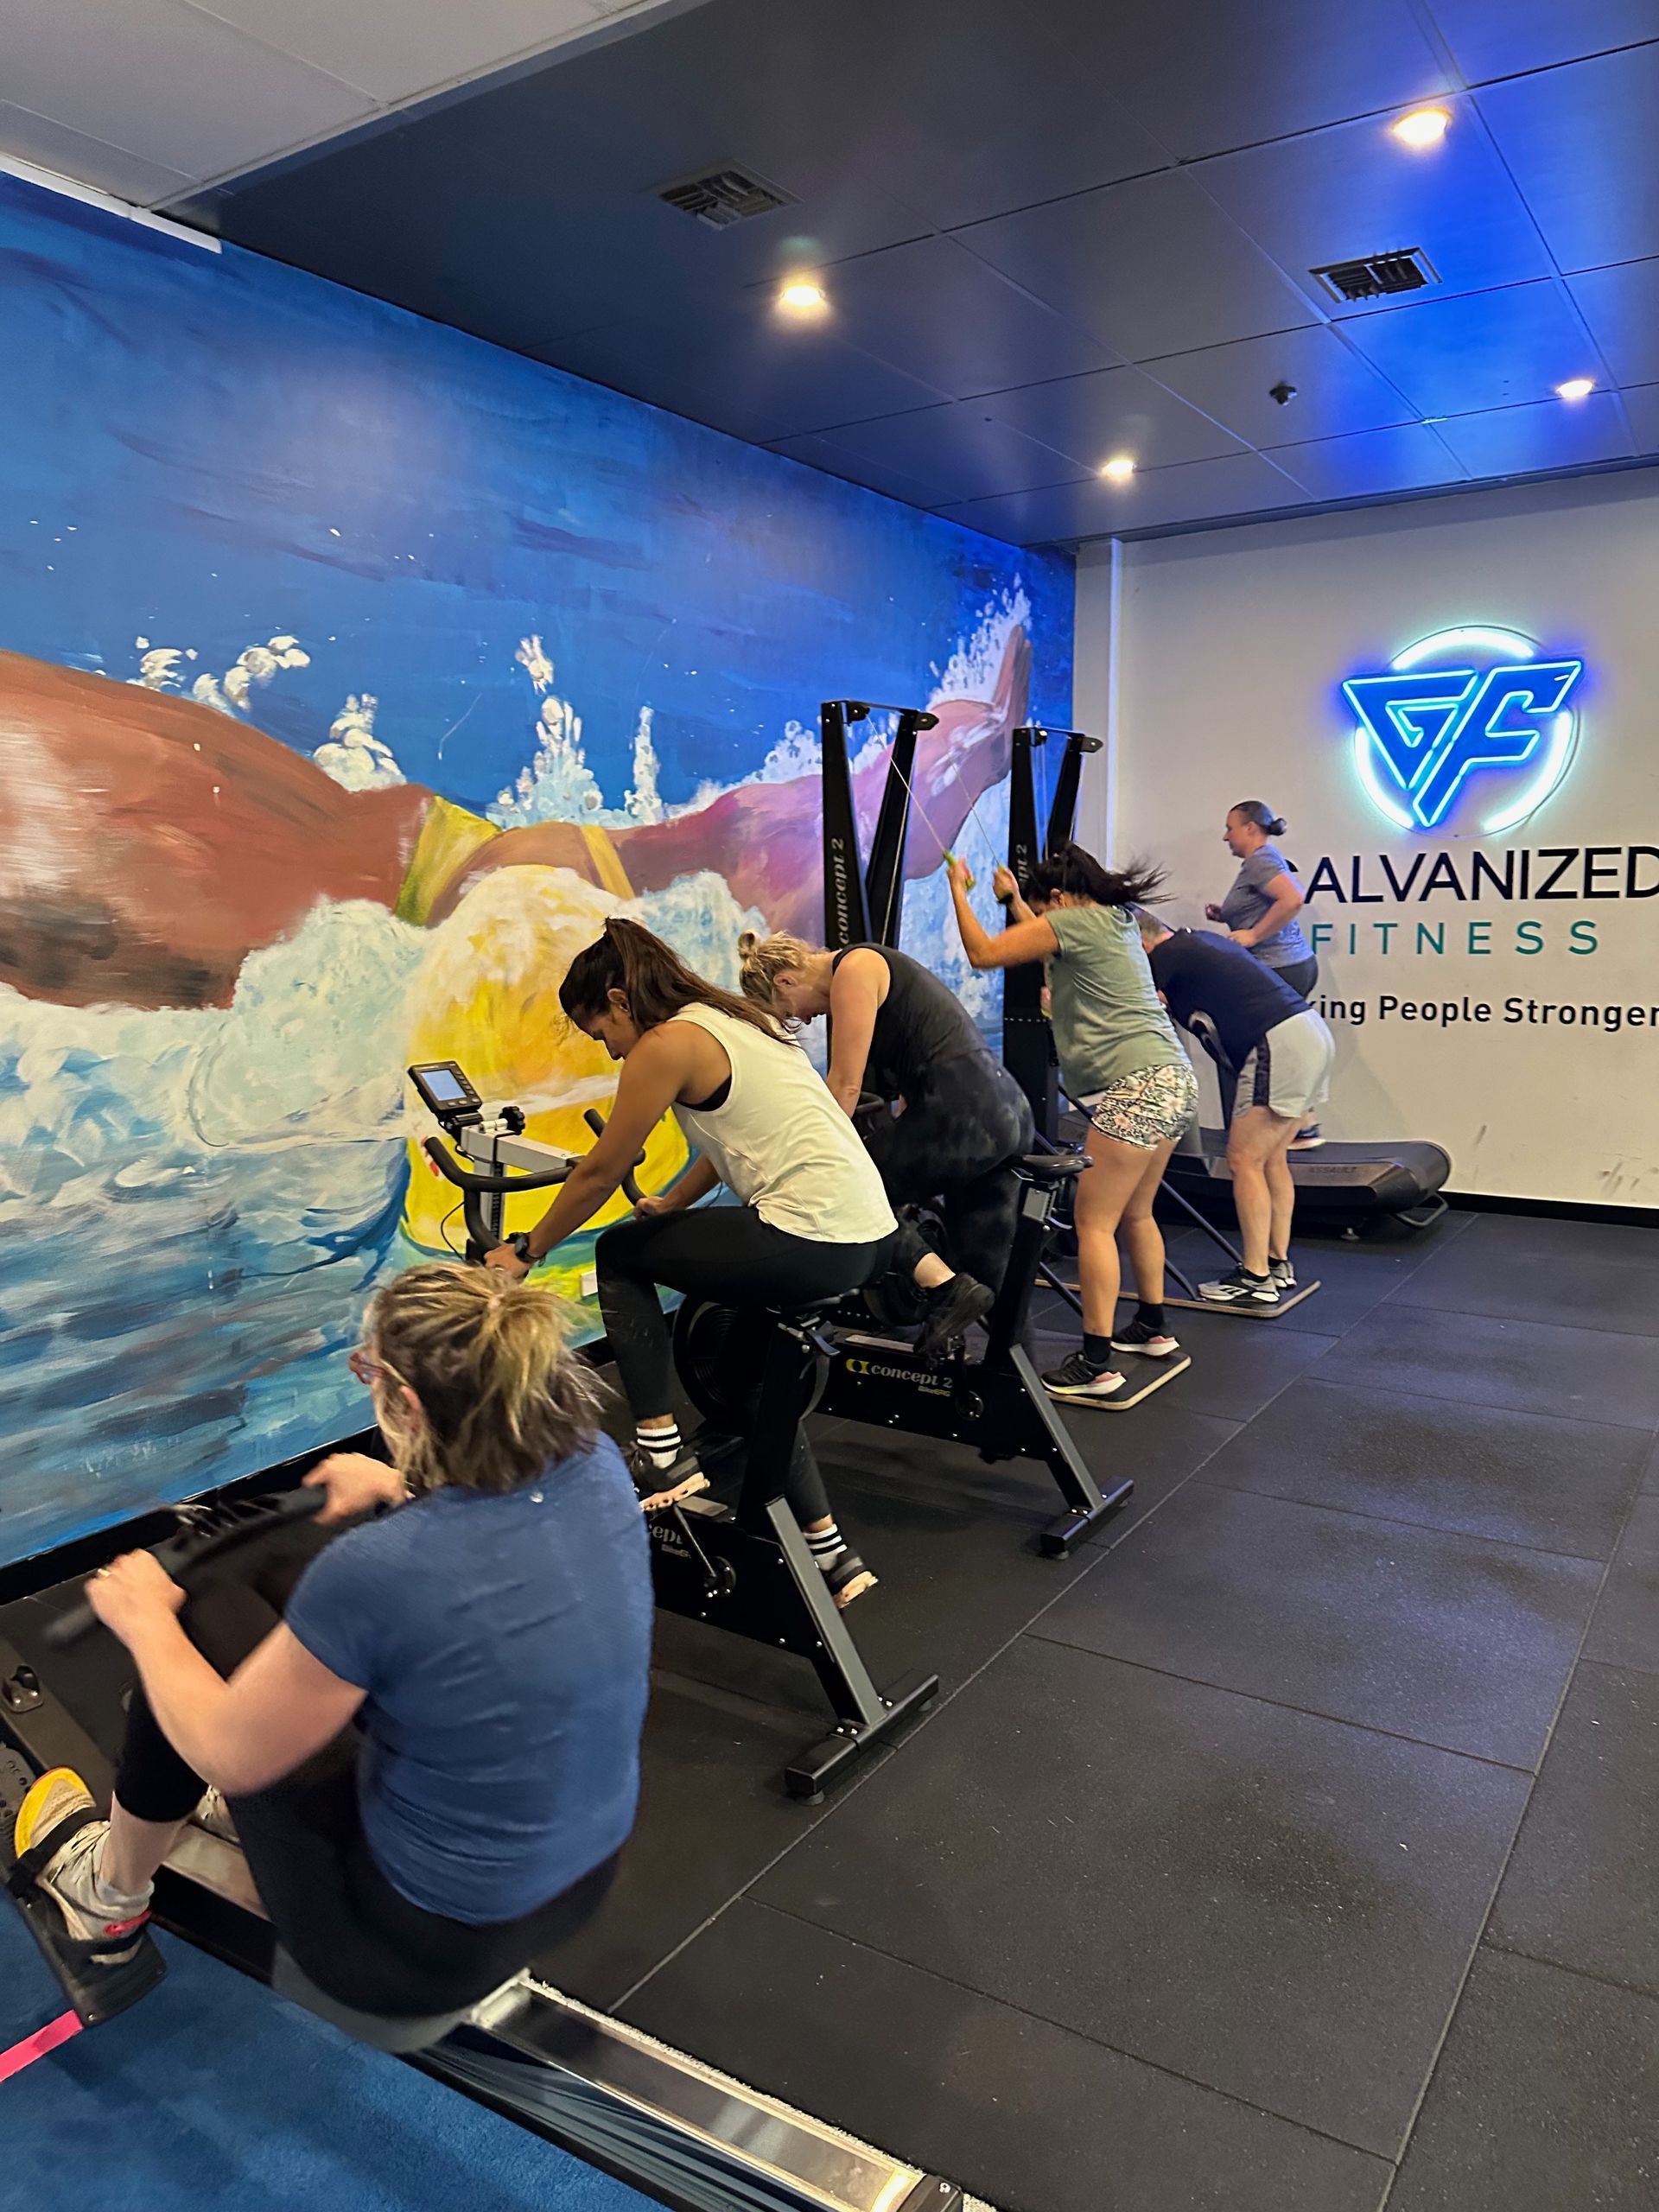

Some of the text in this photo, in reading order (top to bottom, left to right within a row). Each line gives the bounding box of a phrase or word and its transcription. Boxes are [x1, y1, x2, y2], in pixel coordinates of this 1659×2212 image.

[831, 837, 849, 944] concept 2
[1285, 845, 1659, 905] ALVANIZED
[1311, 920, 1599, 955] FITNESS
[1308, 995, 1659, 1033] ing People Stronger
[870, 1364, 953, 1389] concept 2
